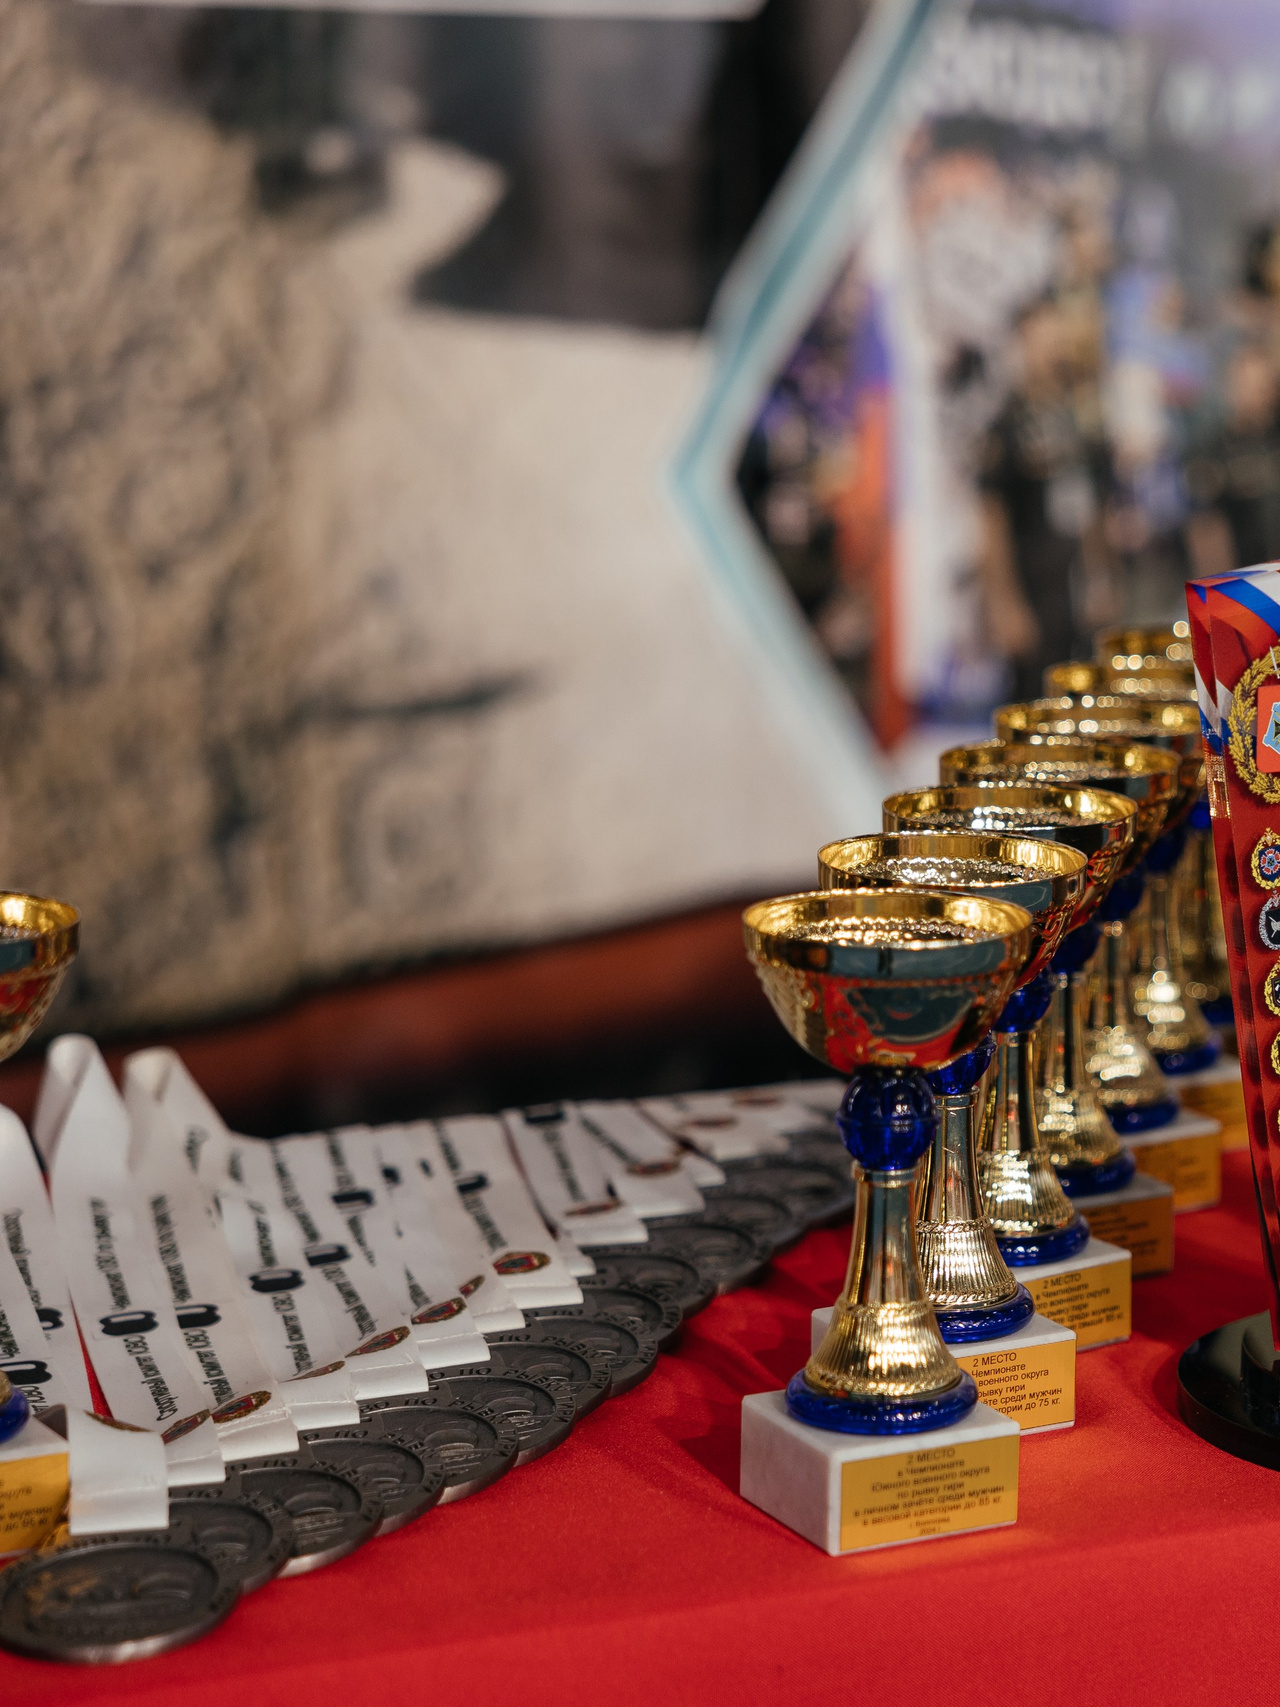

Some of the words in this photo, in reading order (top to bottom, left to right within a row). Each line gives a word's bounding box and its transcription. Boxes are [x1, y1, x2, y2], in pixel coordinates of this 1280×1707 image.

[973, 1358, 979, 1367] 2
[981, 1352, 1017, 1366] МЕСТО
[971, 1363, 1026, 1378] Чемпионате
[978, 1374, 1019, 1387] военного
[1021, 1369, 1049, 1381] округа
[1000, 1393, 1026, 1405] среди
[1028, 1387, 1062, 1400] мужчин
[1006, 1384, 1026, 1394] гири
[1025, 1401, 1037, 1411] до
[1039, 1398, 1049, 1407] 75
[917, 1448, 956, 1463] МЕСТО
[906, 1459, 965, 1476] Чемпионате
[960, 1466, 990, 1480] округа
